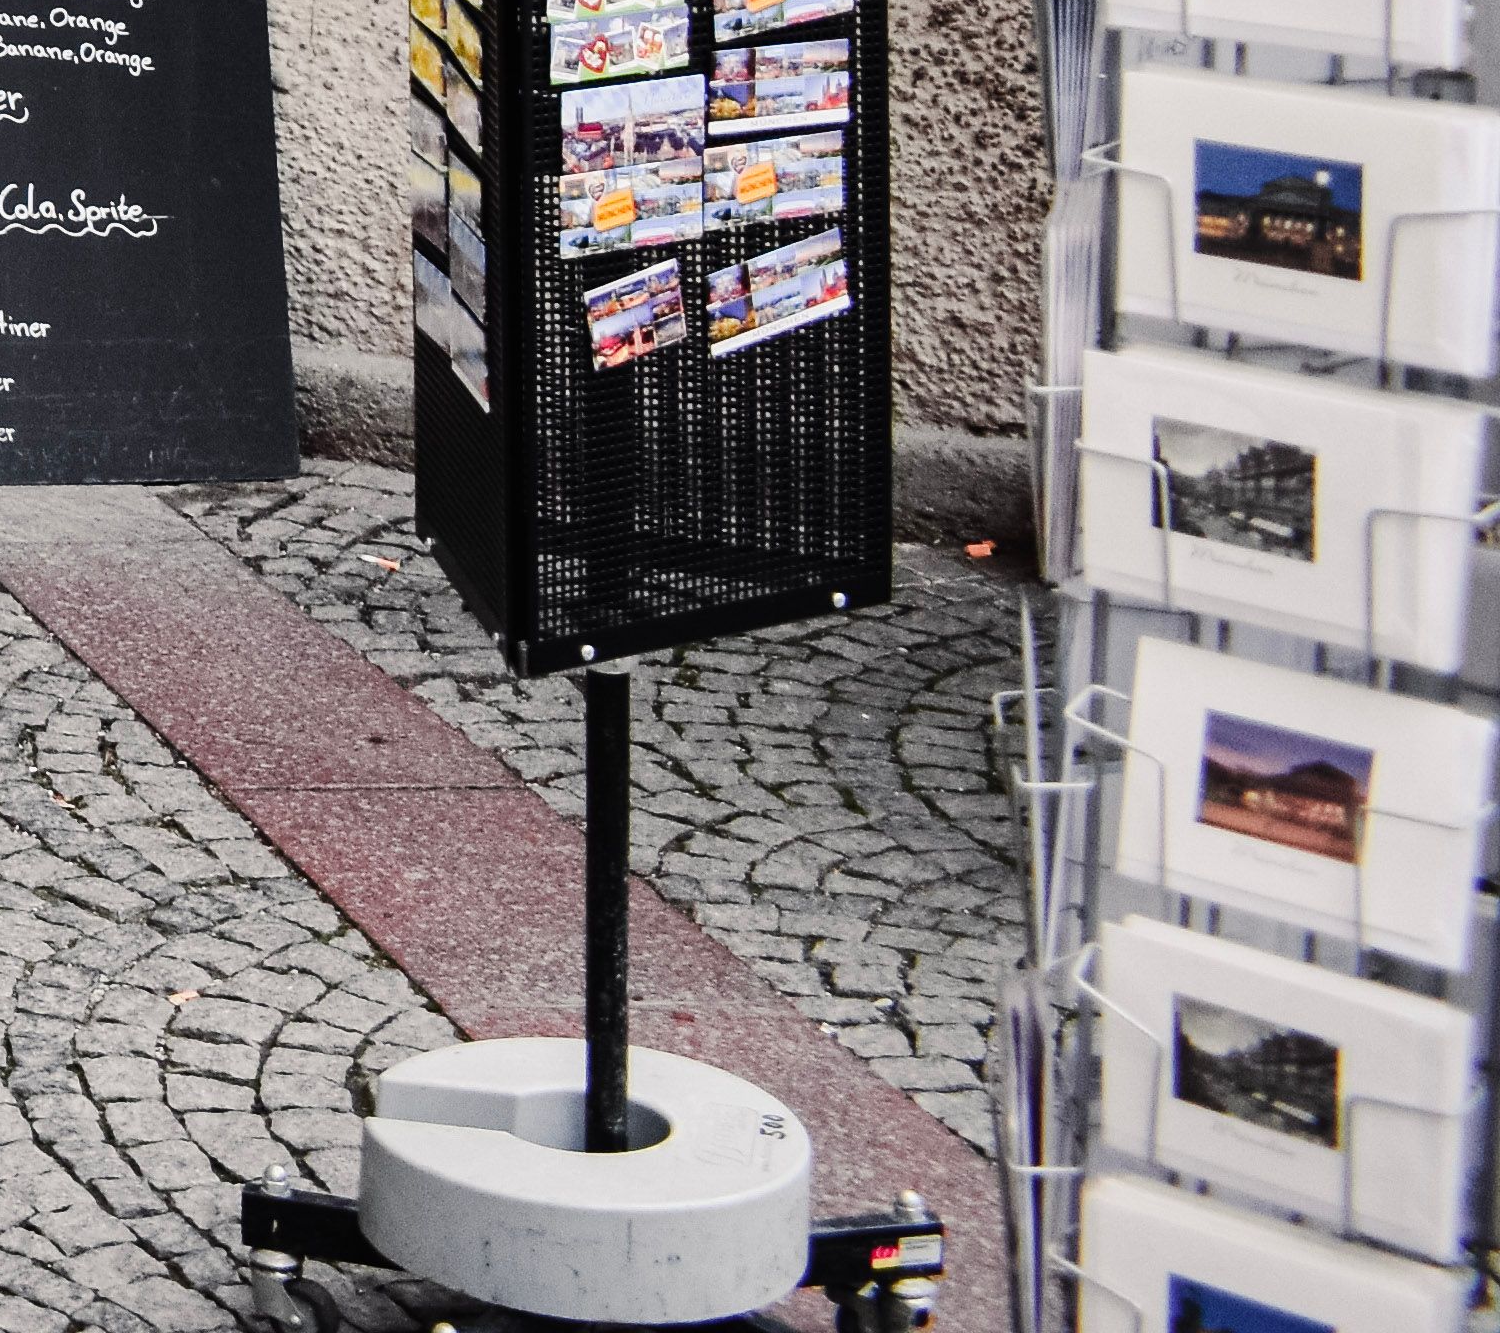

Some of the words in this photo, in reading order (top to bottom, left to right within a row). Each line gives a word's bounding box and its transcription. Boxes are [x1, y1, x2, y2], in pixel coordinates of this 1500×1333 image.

[49, 8, 129, 45] Orange
[80, 42, 155, 76] Orange
[68, 189, 148, 233] Sprite
